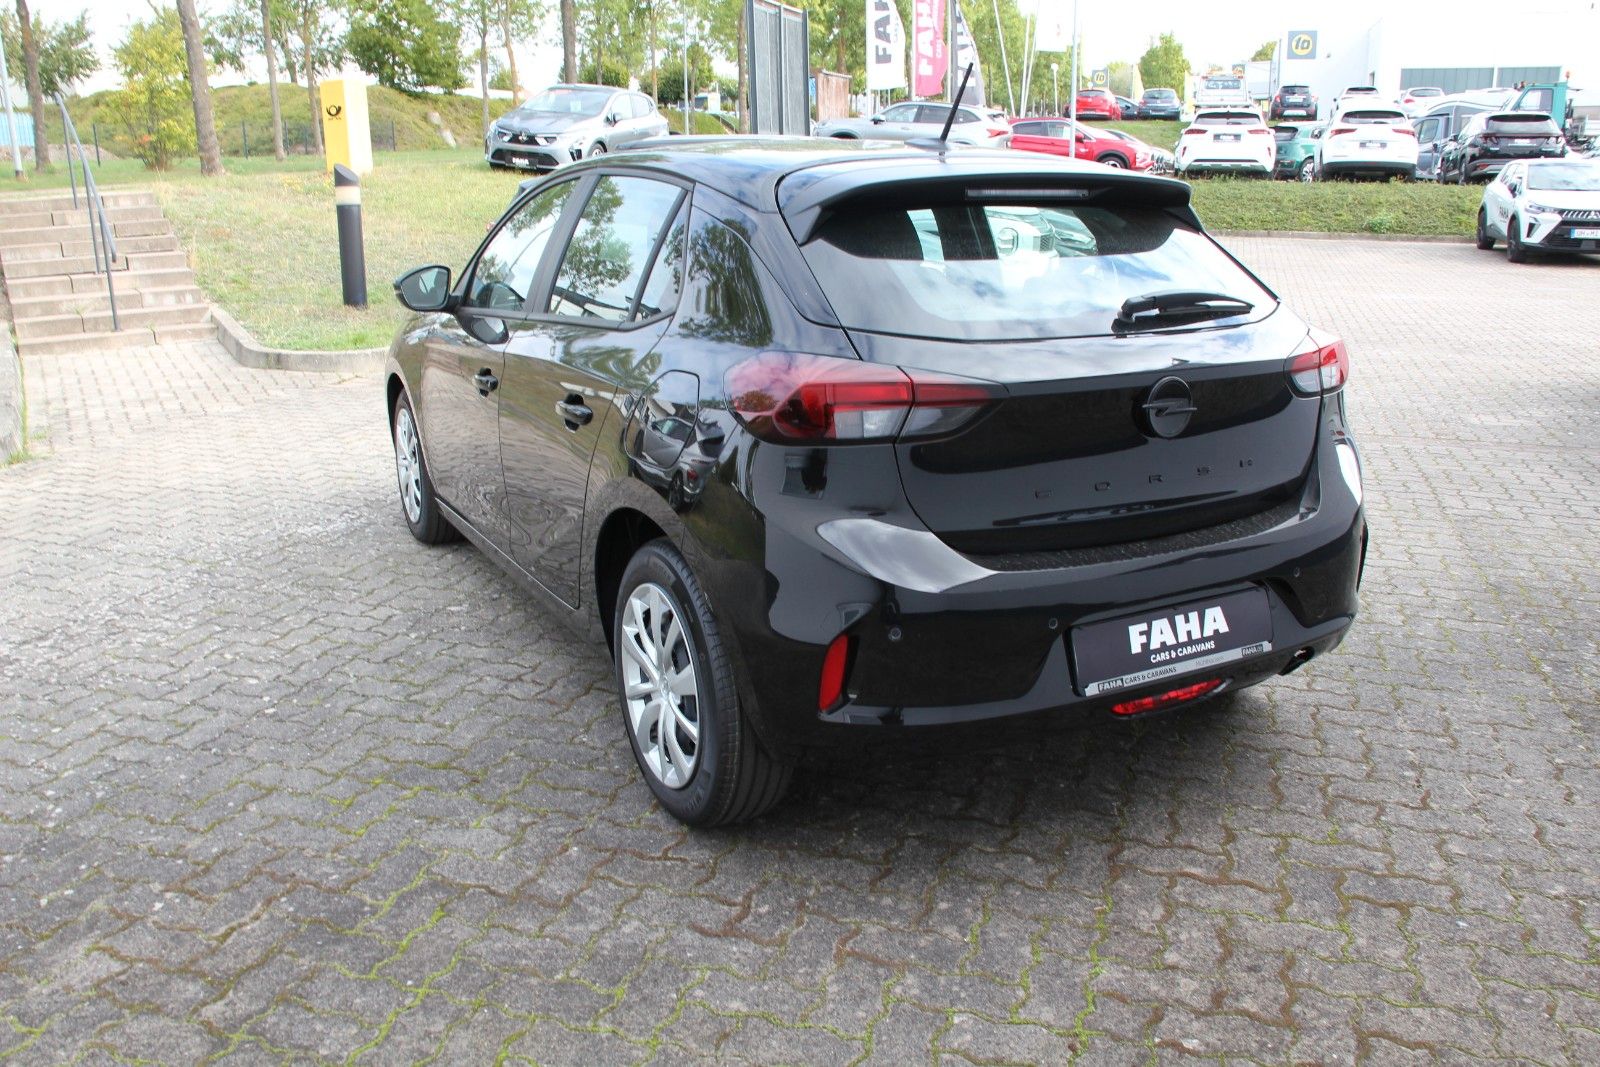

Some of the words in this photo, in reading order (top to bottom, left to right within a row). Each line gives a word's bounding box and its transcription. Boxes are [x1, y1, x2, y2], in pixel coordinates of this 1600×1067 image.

[916, 0, 935, 76] FAH
[1128, 606, 1229, 654] FAHA
[1150, 651, 1170, 663] CARS
[1170, 650, 1177, 658] &
[1177, 640, 1216, 656] CARAVANS
[1098, 679, 1122, 691] FAHA
[1124, 675, 1141, 685] CARS
[1146, 667, 1177, 679] CARAVANS
